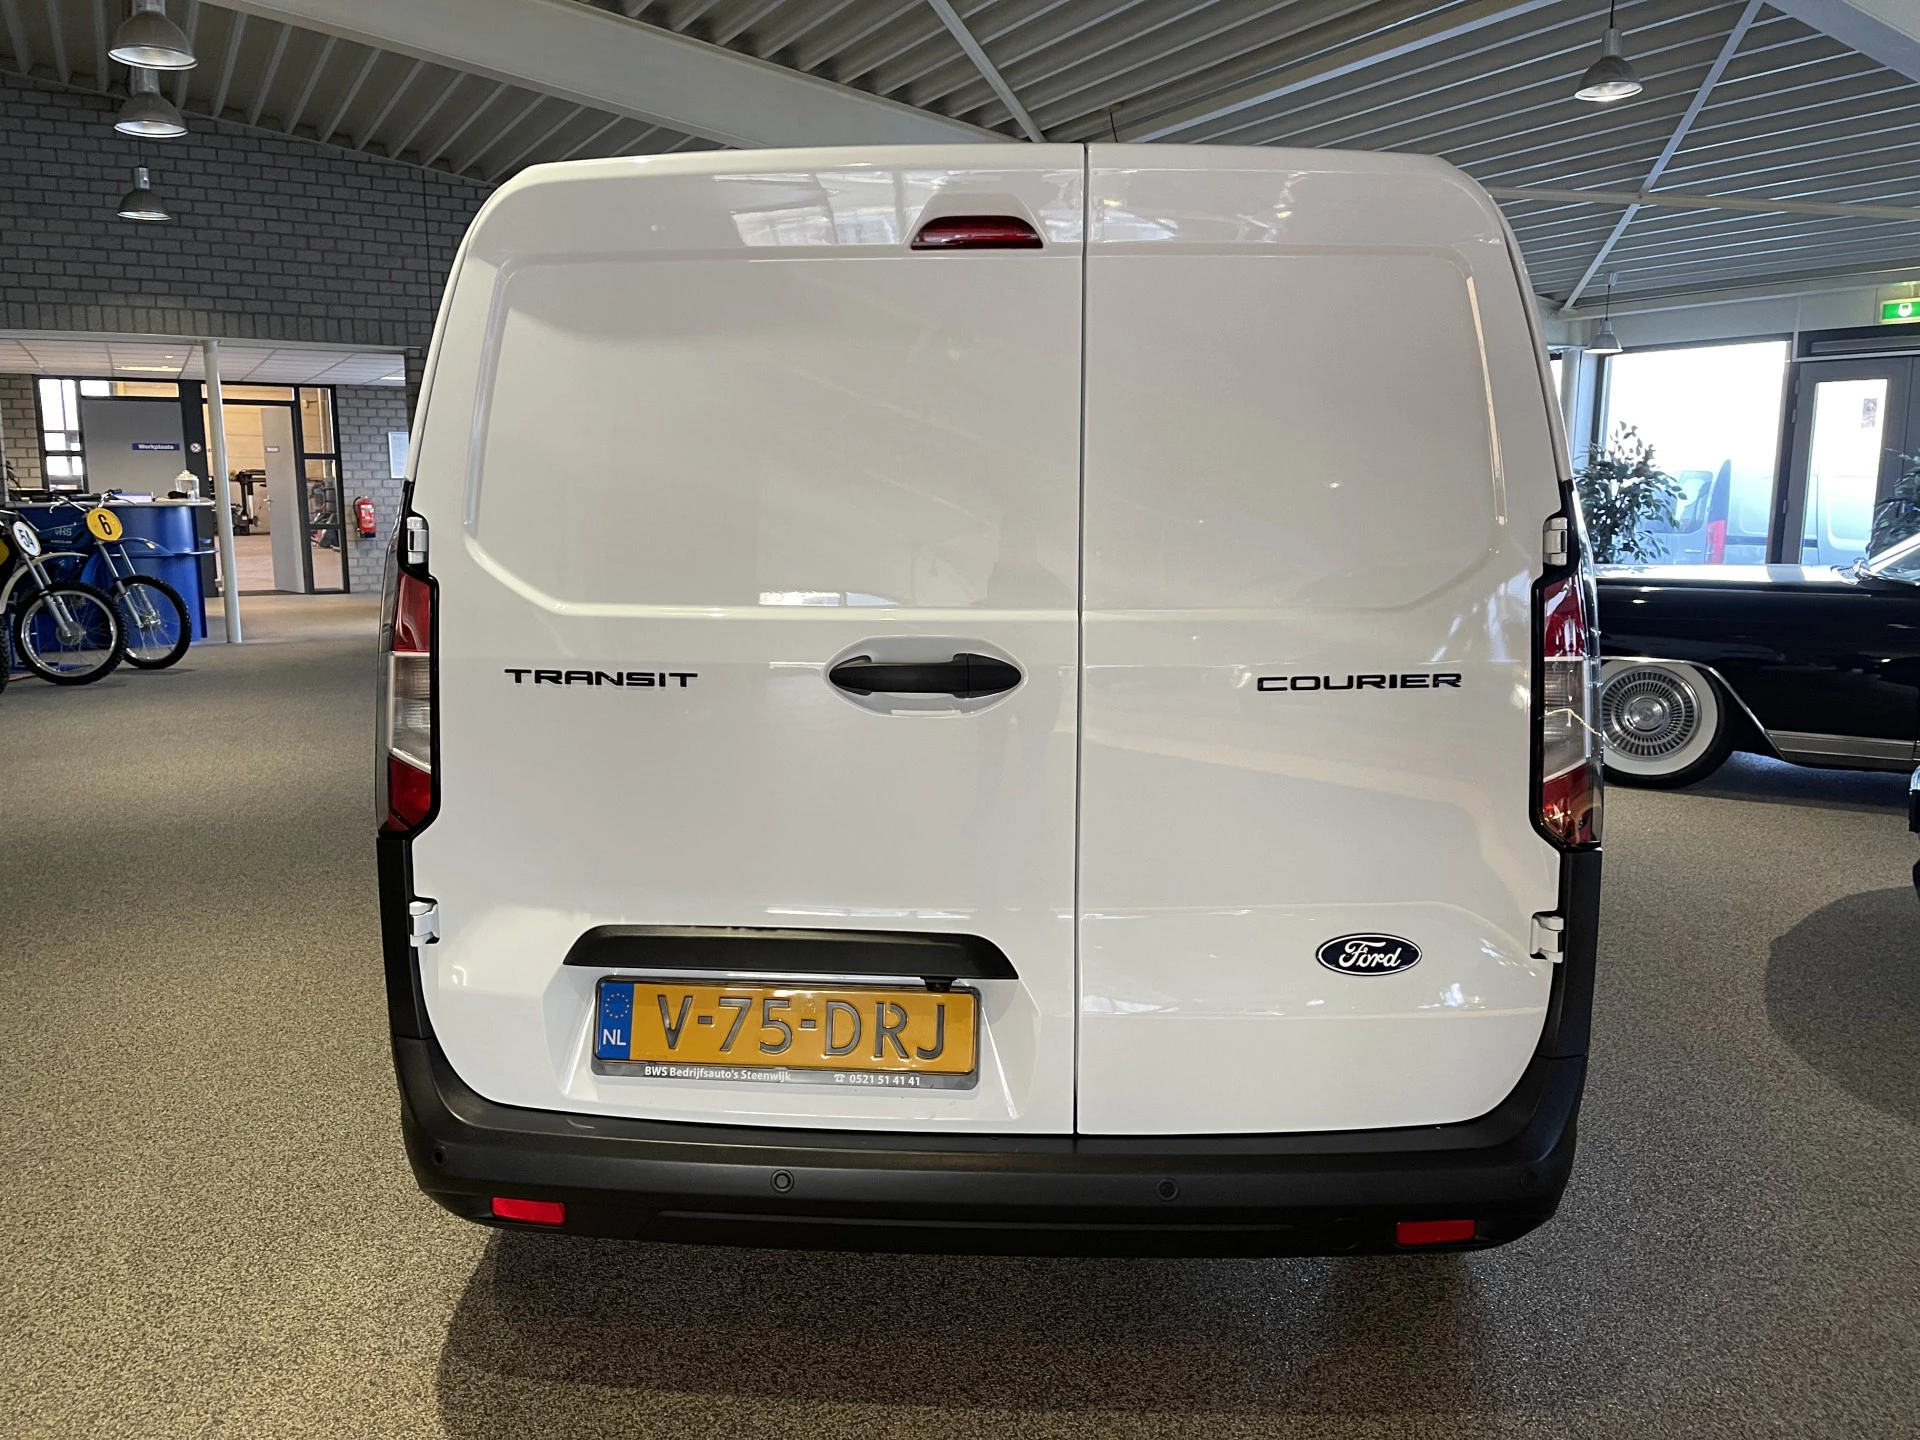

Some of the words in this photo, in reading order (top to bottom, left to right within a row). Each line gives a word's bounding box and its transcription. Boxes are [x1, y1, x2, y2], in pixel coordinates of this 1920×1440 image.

[98, 514, 112, 535] 6
[17, 529, 36, 548] 54
[504, 668, 698, 688] TRANSIT
[1257, 673, 1462, 692] COURIER
[1338, 940, 1402, 968] Ford
[657, 994, 946, 1059] V-75-DRJ
[602, 1028, 627, 1046] NL
[644, 1066, 668, 1077] BWS
[669, 1067, 739, 1080] Bedrijfsauto's
[741, 1069, 792, 1083] Steenwijk
[849, 1074, 874, 1084] 0521
[877, 1075, 889, 1085] 51
[893, 1076, 904, 1085] 41
[908, 1076, 920, 1086] 41
